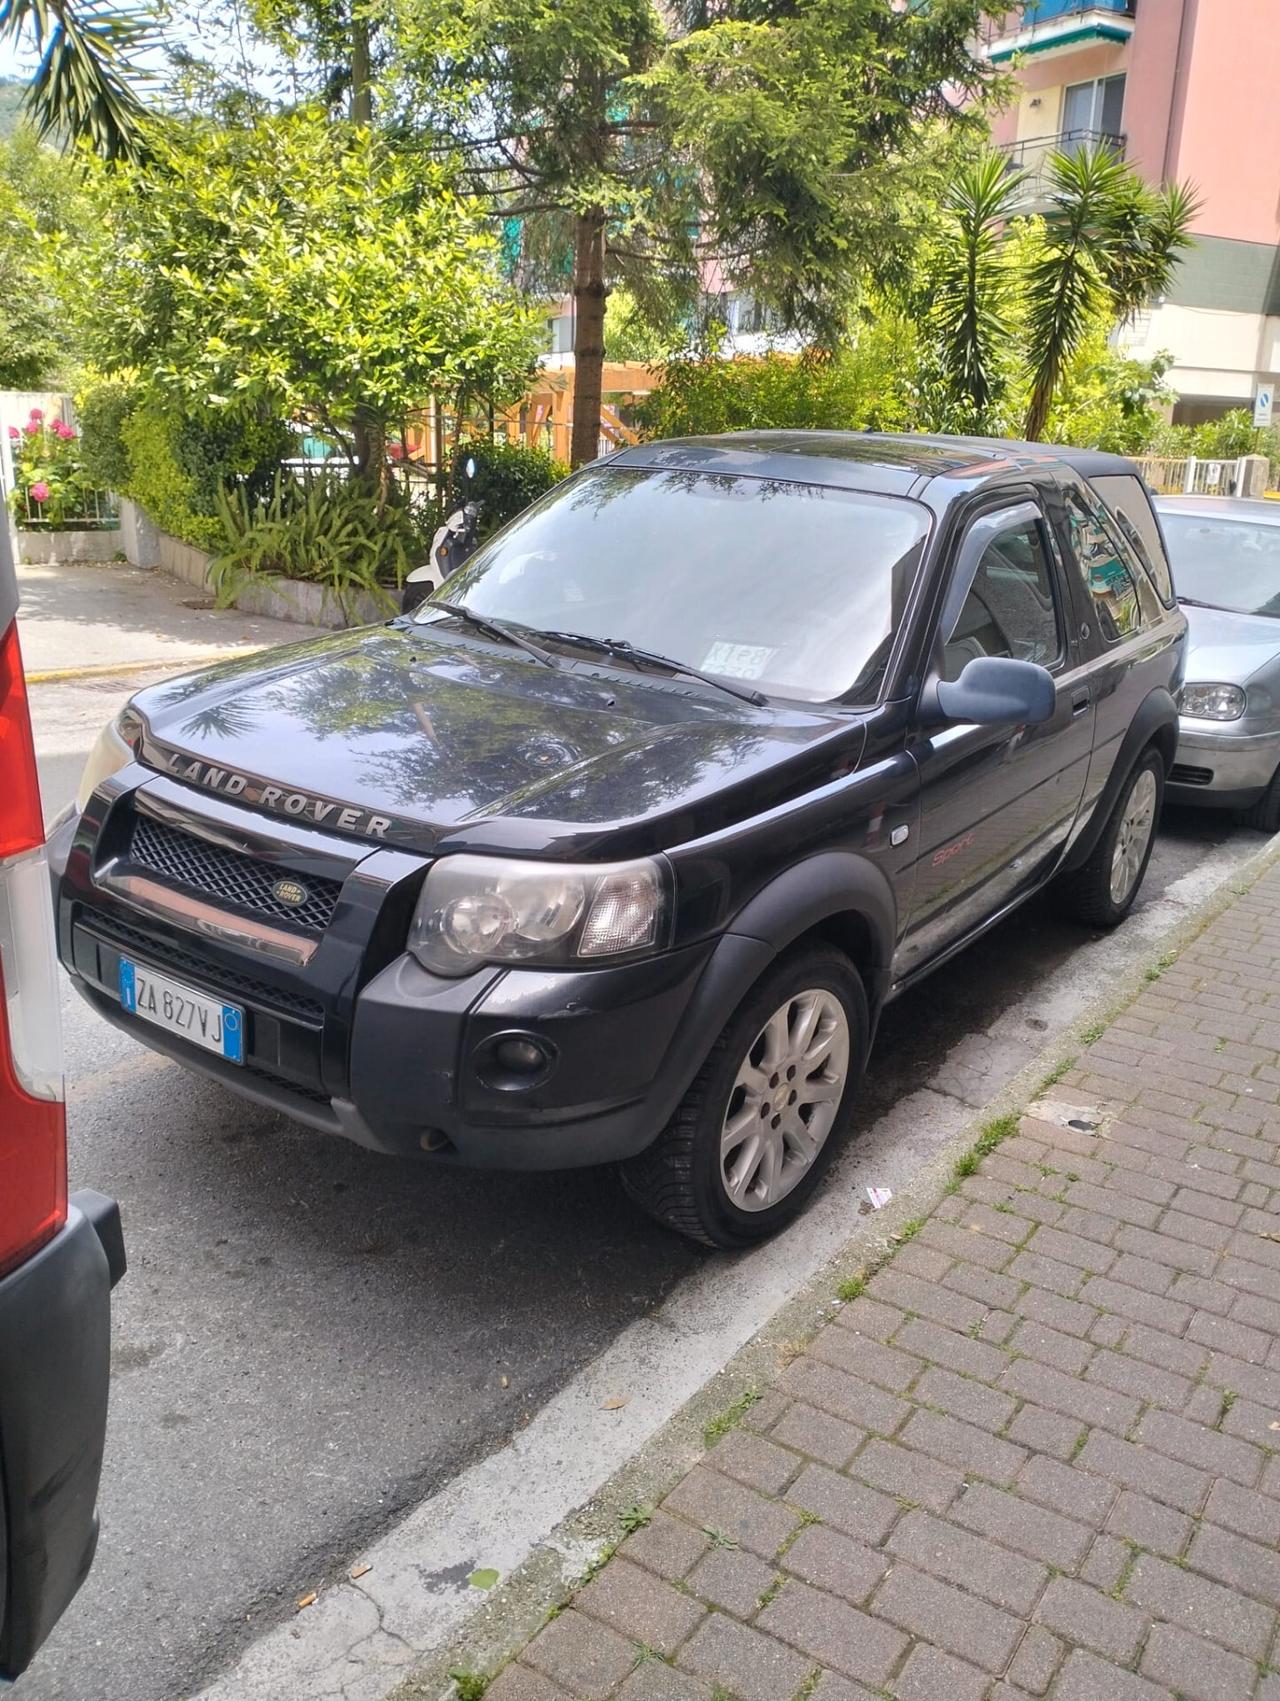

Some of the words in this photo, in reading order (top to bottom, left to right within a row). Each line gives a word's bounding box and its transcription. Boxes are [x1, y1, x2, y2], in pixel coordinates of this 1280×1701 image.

[168, 753, 248, 796] LAND
[259, 786, 393, 839] ROVER
[931, 832, 976, 867] Sport
[279, 883, 298, 894] LAND
[279, 890, 301, 902] ROVER
[136, 977, 158, 1016] ZA
[163, 990, 221, 1042] 827VJ
